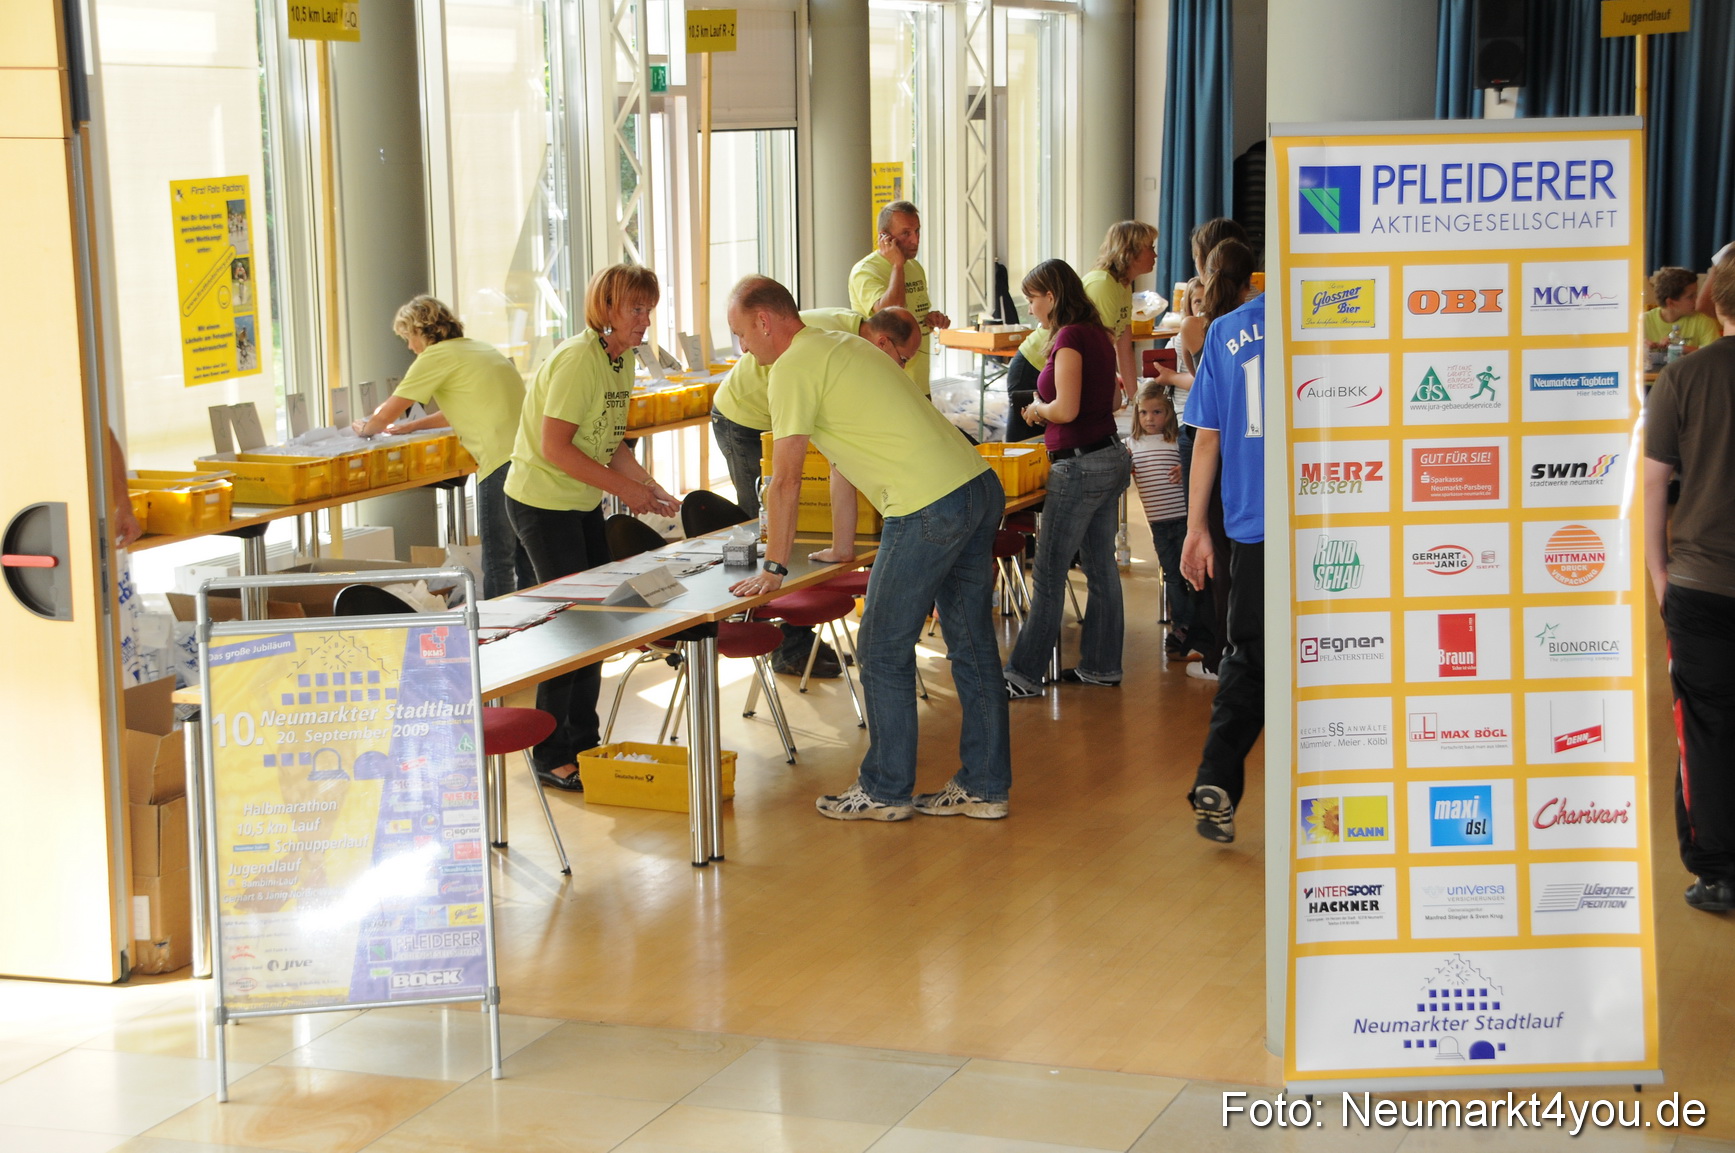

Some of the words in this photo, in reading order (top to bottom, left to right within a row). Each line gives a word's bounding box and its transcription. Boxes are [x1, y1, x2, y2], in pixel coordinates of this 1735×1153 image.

[291, 6, 307, 24] 10,5
[308, 6, 320, 22] km
[322, 8, 338, 23] Lauf
[1621, 8, 1672, 26] Jugendlauf
[700, 25, 708, 37] km
[710, 24, 722, 37] Lauf
[222, 184, 245, 194] Factory
[1371, 159, 1617, 205] PFLEIDERER
[1371, 210, 1618, 234] AKTIENGESELLSCHAFT
[1312, 286, 1362, 315] Glossner
[1407, 289, 1504, 315] OBI
[1533, 286, 1589, 306] MCM
[1337, 302, 1361, 314] Bier
[1226, 324, 1264, 356] BAL
[1533, 377, 1579, 388] Neumarkter
[1580, 376, 1615, 388] Tagblatt
[1307, 387, 1336, 398] Audi
[1338, 386, 1368, 397] BKK
[1410, 402, 1502, 411] www.jura-gebaeudeservice.de
[1420, 453, 1444, 464] GUT
[1446, 451, 1467, 464] FÜR
[1470, 452, 1492, 462] SIE!
[1302, 462, 1383, 483] MERZ
[1530, 462, 1588, 480] swn
[1298, 476, 1362, 496] Reisen
[1315, 535, 1358, 566] RUND
[1412, 552, 1461, 560] GERHART
[1544, 552, 1606, 564] WITTMANN
[1314, 565, 1364, 590] SCHAU
[1552, 569, 1598, 585] VERPACKUNG
[208, 653, 224, 662] Das
[225, 648, 251, 660] große
[252, 640, 292, 654] Jubiläum
[422, 650, 444, 658] DKMS
[1549, 640, 1619, 652] BIONORICA
[1320, 653, 1384, 662] PFLASTERSTEINE
[1438, 649, 1474, 665] Braun
[260, 705, 378, 727] Neumarkter
[384, 698, 474, 720] Stadtlauf
[212, 712, 264, 748] 10.
[276, 731, 299, 744] 20.
[304, 726, 390, 744] September
[393, 723, 430, 738] 2009
[1300, 727, 1326, 735] RECHTS
[1347, 724, 1388, 732] ANWÄLTE
[1441, 730, 1470, 738] MAX
[1474, 727, 1508, 738] BÖGL
[1300, 740, 1332, 749] Mümmler
[1368, 738, 1388, 746] Kölbl
[1566, 732, 1590, 746] DEHN
[244, 800, 338, 816] Halbmarathon
[1434, 796, 1480, 820] maxi
[1533, 797, 1631, 830] Charivari
[237, 822, 264, 836] 10,5
[267, 821, 288, 834] km
[292, 818, 322, 832] Lauf
[1348, 827, 1384, 837] KANN
[1466, 818, 1486, 835] dsl
[274, 833, 369, 854] Schnupperlauf
[228, 858, 302, 878] Jugendlauf
[1314, 884, 1383, 898] INTERSPORT
[1583, 883, 1634, 898] Wagner
[1308, 900, 1380, 914] HACKNER
[392, 970, 464, 990] BOCK
[1354, 1016, 1469, 1034] Neumarkter
[1474, 1012, 1564, 1031] Stadtlauf
